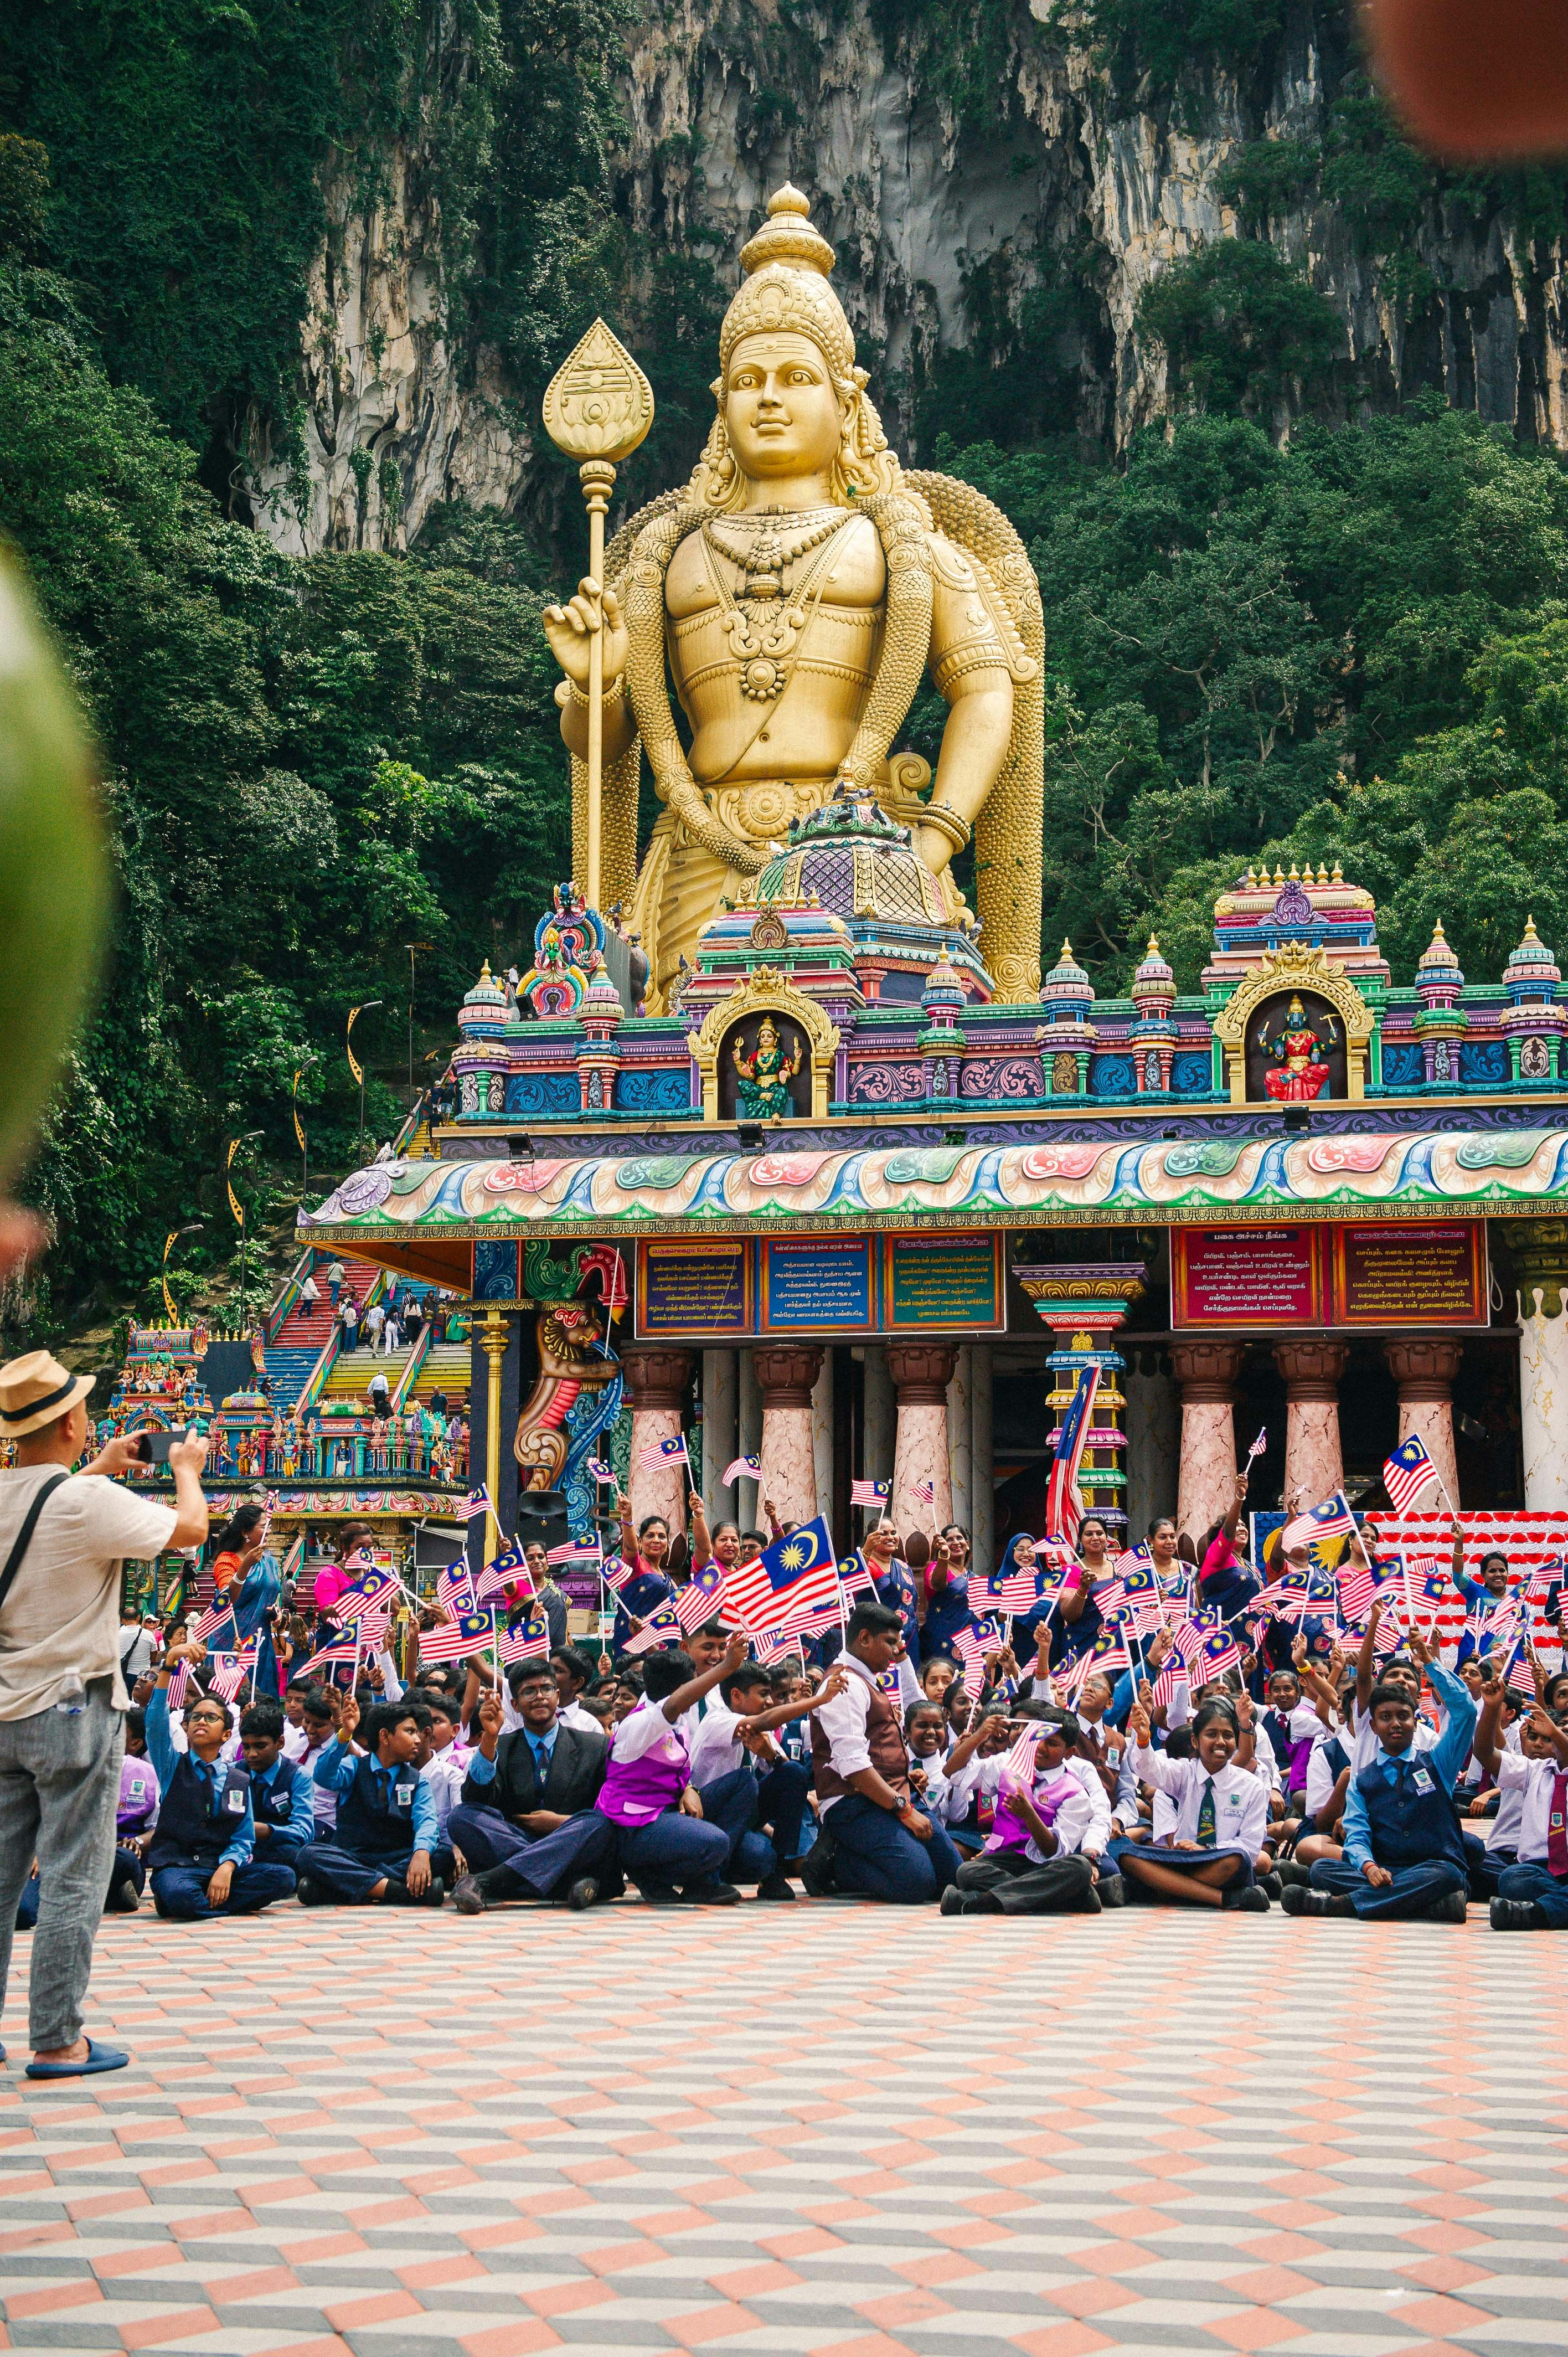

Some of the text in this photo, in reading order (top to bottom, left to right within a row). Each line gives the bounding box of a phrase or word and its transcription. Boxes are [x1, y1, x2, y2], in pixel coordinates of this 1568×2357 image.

[1266, 1232, 1287, 1240] நீங்க
[1373, 1231, 1436, 1239] செல்வங்களையும்
[1280, 1261, 1309, 1270] உண்ணும்
